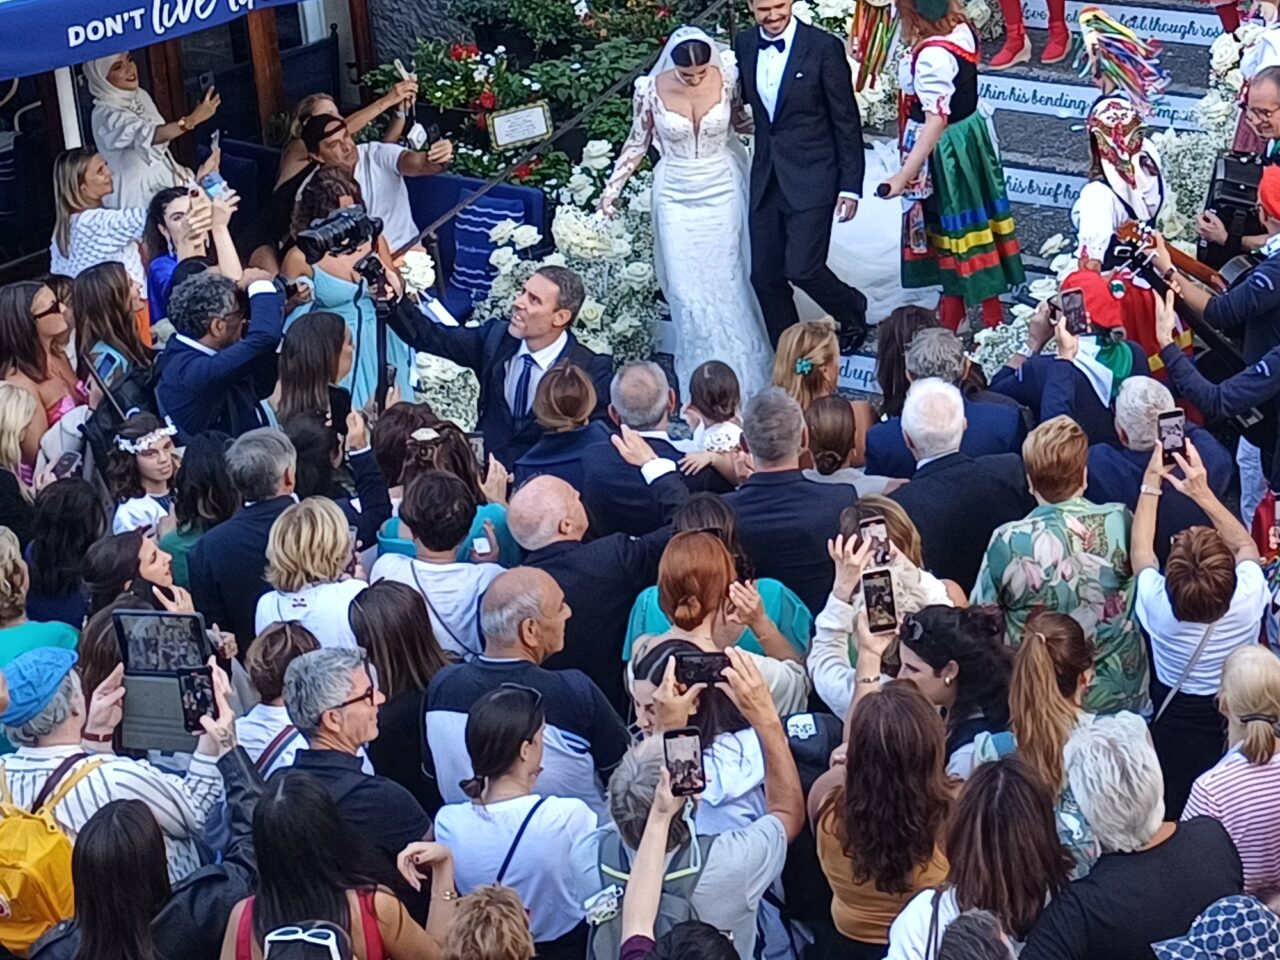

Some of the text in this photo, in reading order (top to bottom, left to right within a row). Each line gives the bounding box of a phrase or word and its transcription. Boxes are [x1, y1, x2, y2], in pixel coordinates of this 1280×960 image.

[68, 8, 145, 47] DON'T
[1008, 86, 1029, 104] his
[1031, 89, 1090, 116] bending
[1005, 175, 1027, 193] his
[1028, 179, 1063, 203] brief
